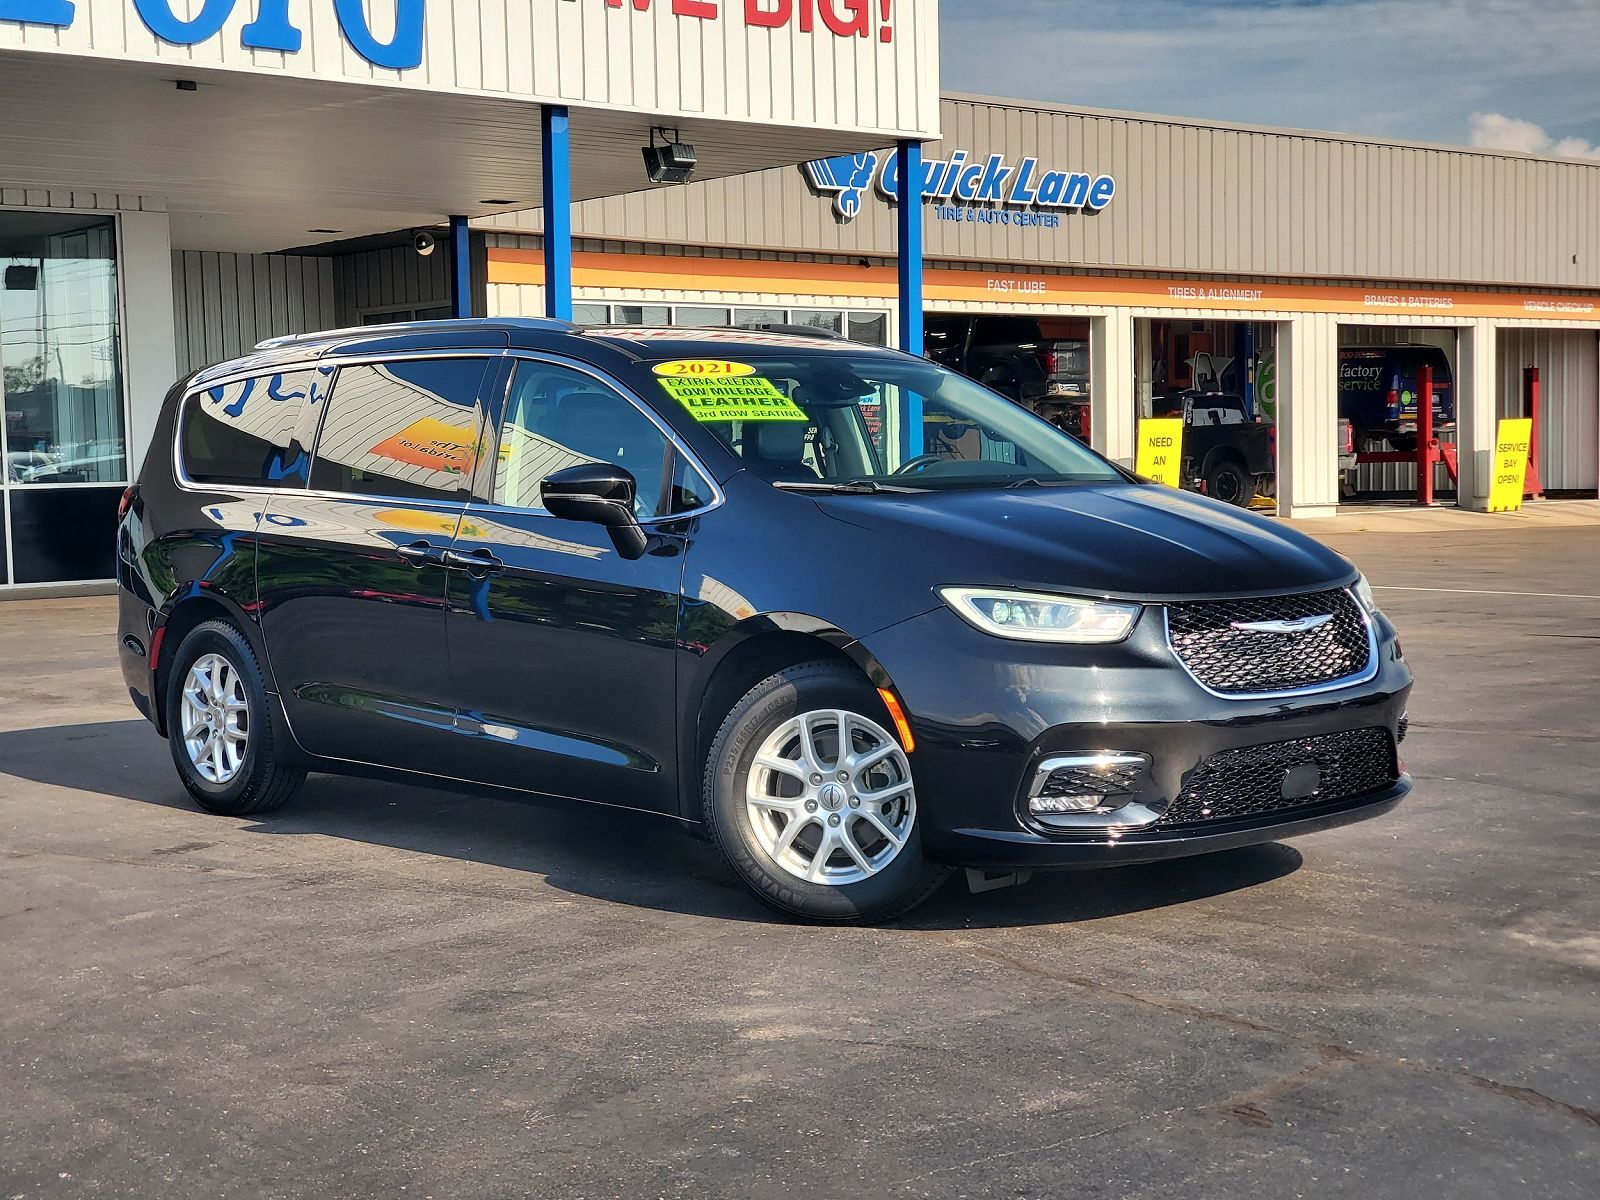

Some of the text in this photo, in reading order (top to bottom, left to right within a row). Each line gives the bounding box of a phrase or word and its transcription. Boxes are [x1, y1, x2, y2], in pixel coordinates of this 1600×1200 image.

[1008, 156, 1116, 210] Lane
[935, 206, 1060, 228] TIRE & AUTO CENTER
[987, 279, 1046, 294] FAST LUBE
[1168, 286, 1263, 302] TIRES & ALIGNMENT
[1364, 295, 1454, 309] BRAKES & BATTERIES
[674, 363, 732, 374] 2021
[1339, 363, 1383, 381] factory
[666, 378, 762, 387] EXTRA CLEAN
[1339, 377, 1381, 391] service
[675, 387, 774, 397] LOW MILEAGE
[688, 398, 788, 408] LEATHER
[695, 409, 802, 419] 3rd ROW SEATING
[1149, 437, 1173, 448] NEED
[1498, 442, 1528, 453] SERVICE
[1153, 455, 1167, 466] AN
[1504, 459, 1519, 469] BAY
[1151, 474, 1165, 484] OIL
[1498, 474, 1520, 485] OPEN!
